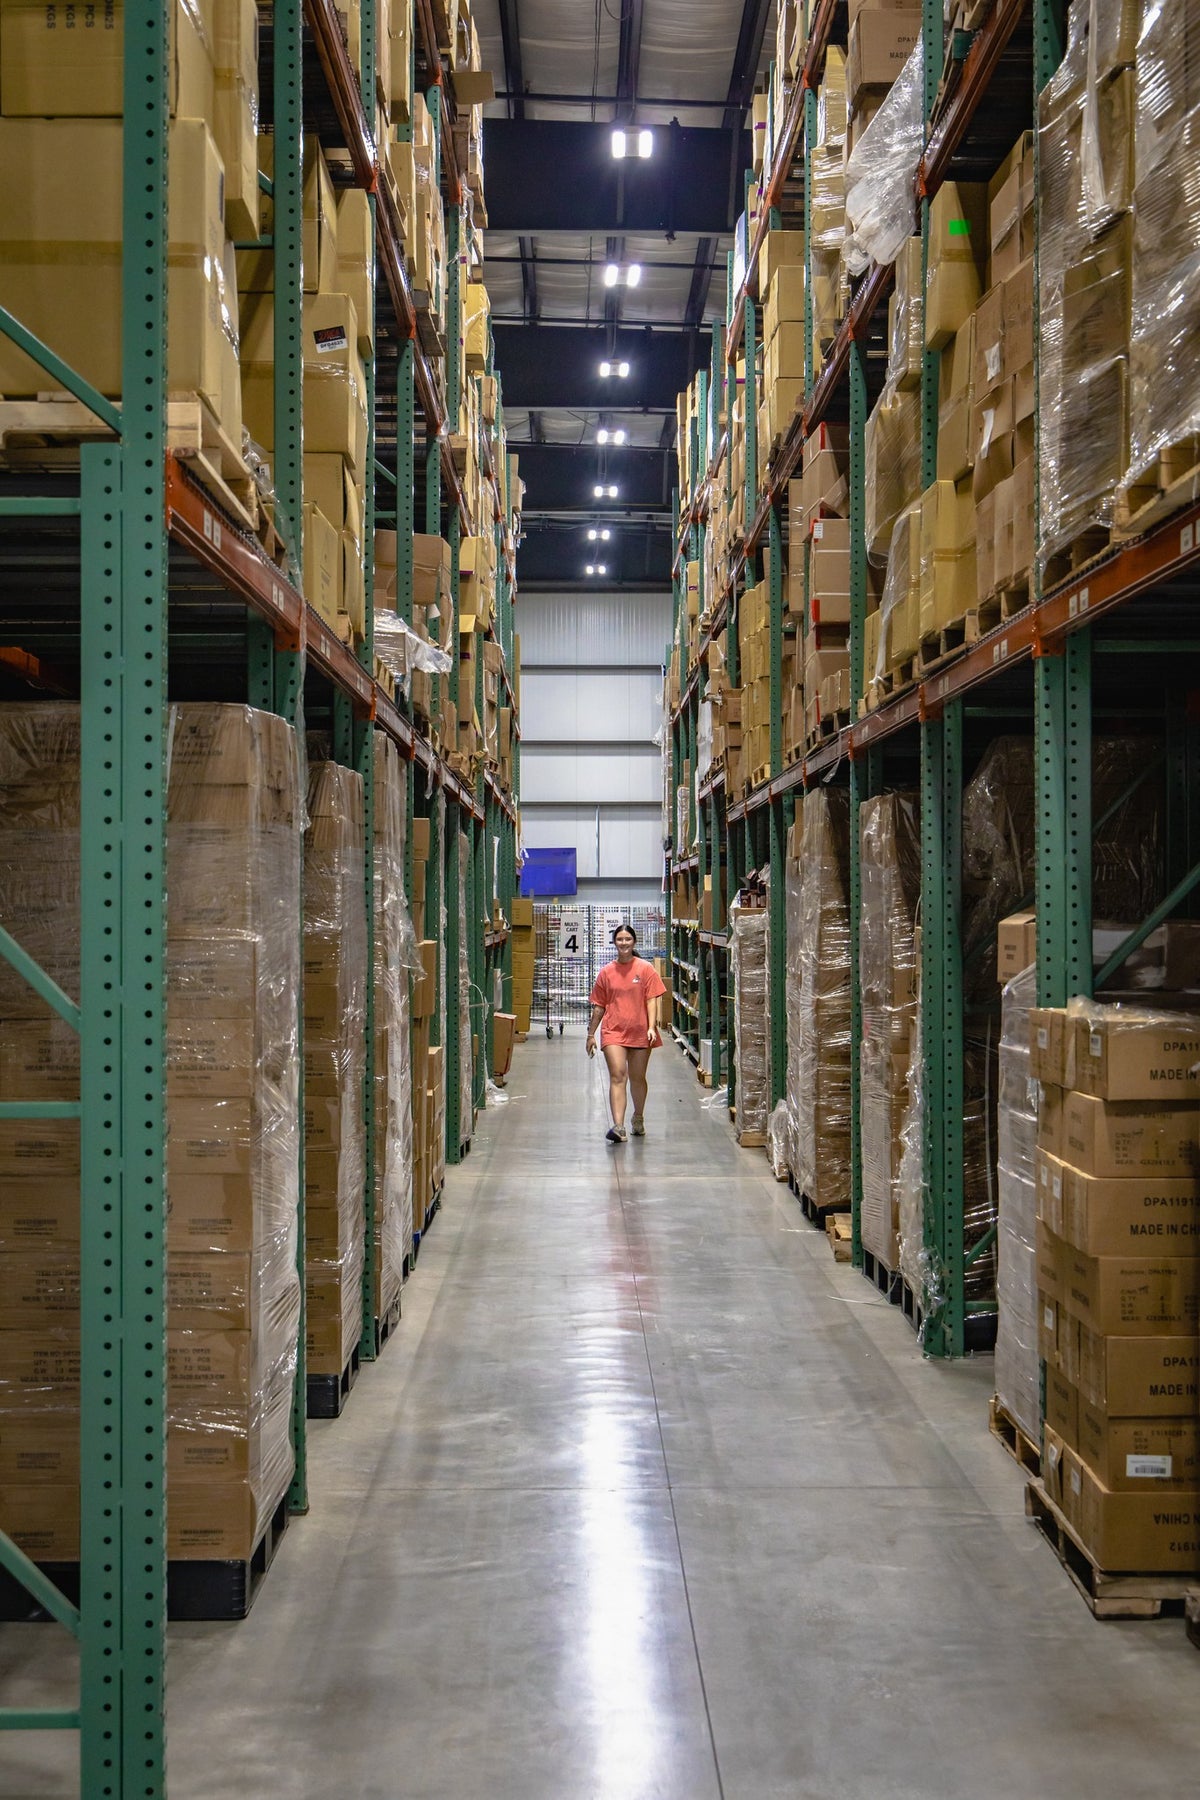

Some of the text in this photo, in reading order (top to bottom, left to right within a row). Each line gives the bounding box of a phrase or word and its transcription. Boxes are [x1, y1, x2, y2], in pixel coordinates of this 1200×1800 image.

[47, 4, 56, 29] KGS
[66, 4, 75, 29] KGS
[85, 4, 95, 28] PCS
[565, 934, 579, 953] 4
[1149, 1068, 1197, 1081] MADE IN
[1129, 1224, 1163, 1235] MADE
[1166, 1224, 1178, 1235] IN
[1149, 1384, 1198, 1396] MADE IN
[1153, 1512, 1190, 1525] CHINA
